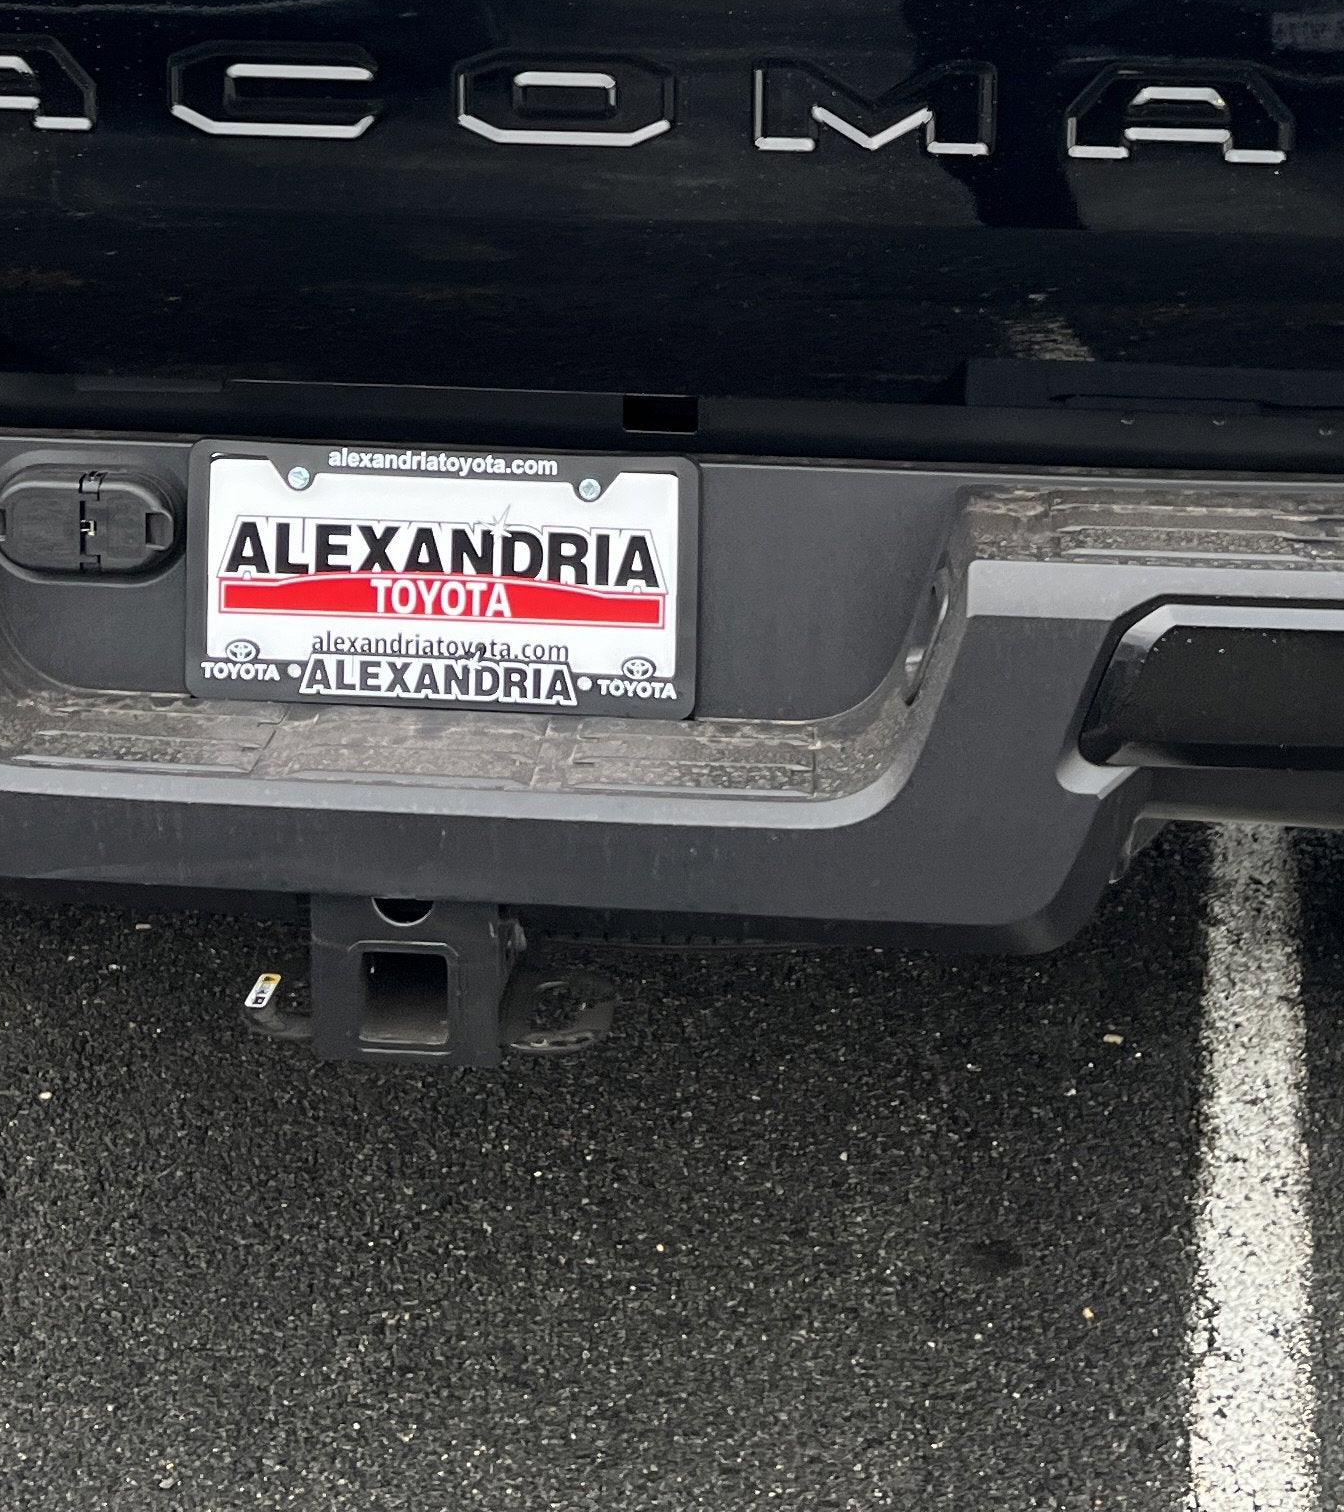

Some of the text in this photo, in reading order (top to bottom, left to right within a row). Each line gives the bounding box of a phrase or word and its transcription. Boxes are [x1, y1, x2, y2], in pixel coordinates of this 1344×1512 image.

[328, 448, 558, 476] alexandriatoyota.com
[225, 521, 661, 589] ALEXANDRIA
[370, 579, 512, 618] TOYOTA
[201, 660, 281, 683] TOYOTA
[305, 658, 572, 701] ALEXANDRIA
[596, 677, 678, 700] TOYOTA
